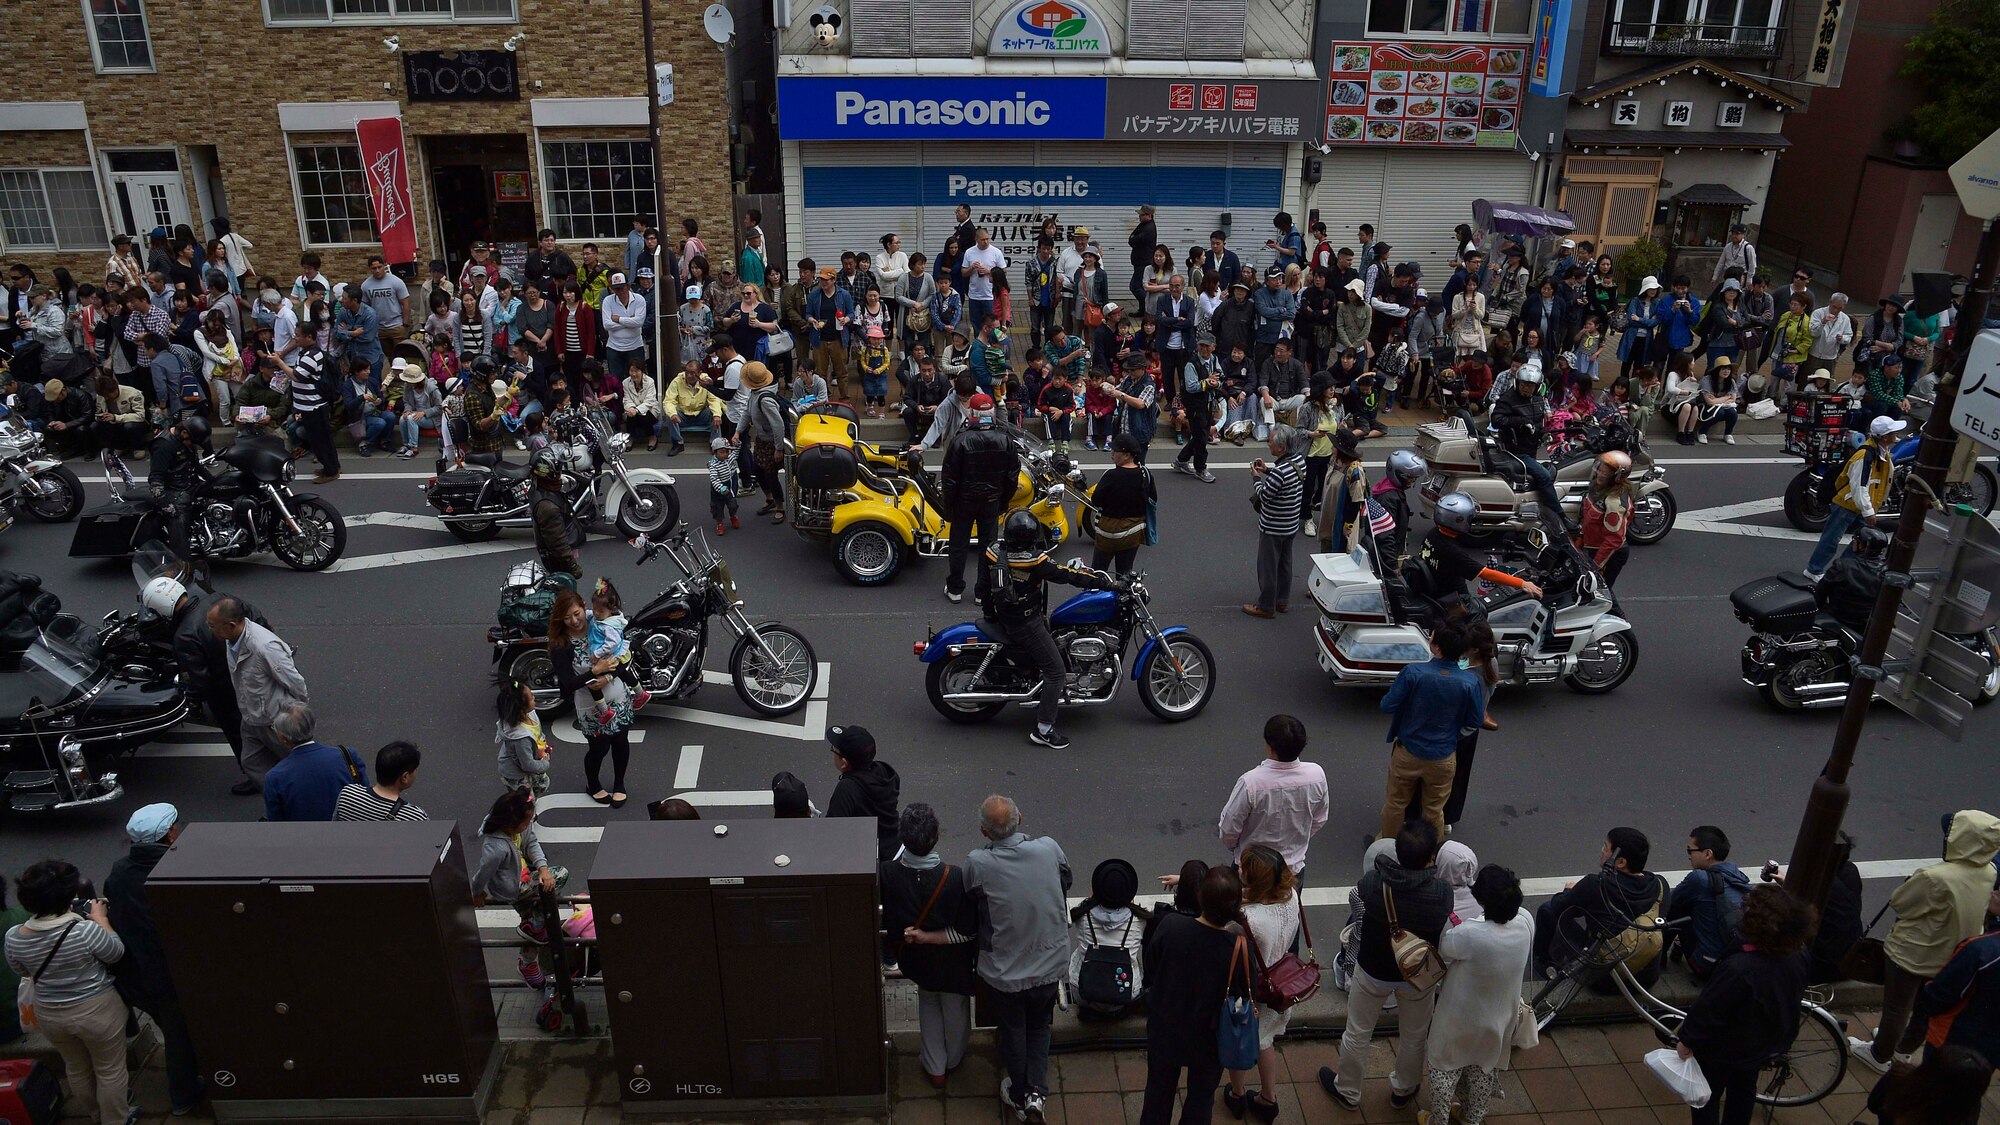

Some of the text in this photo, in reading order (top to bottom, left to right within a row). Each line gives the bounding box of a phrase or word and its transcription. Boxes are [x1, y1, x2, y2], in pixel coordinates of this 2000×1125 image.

[1002, 38, 1099, 50] ネットワーク&エコハウス
[410, 58, 513, 94] hood
[1384, 60, 1476, 71] THAI RESTAURANT
[835, 91, 1050, 125] Panasonic
[1123, 114, 1300, 136] パナデンアキハバラ電器
[948, 174, 1089, 197] Panasonic
[368, 288, 392, 298] VANS
[1965, 413, 2000, 441] TEL.5
[422, 1073, 460, 1084] HG5
